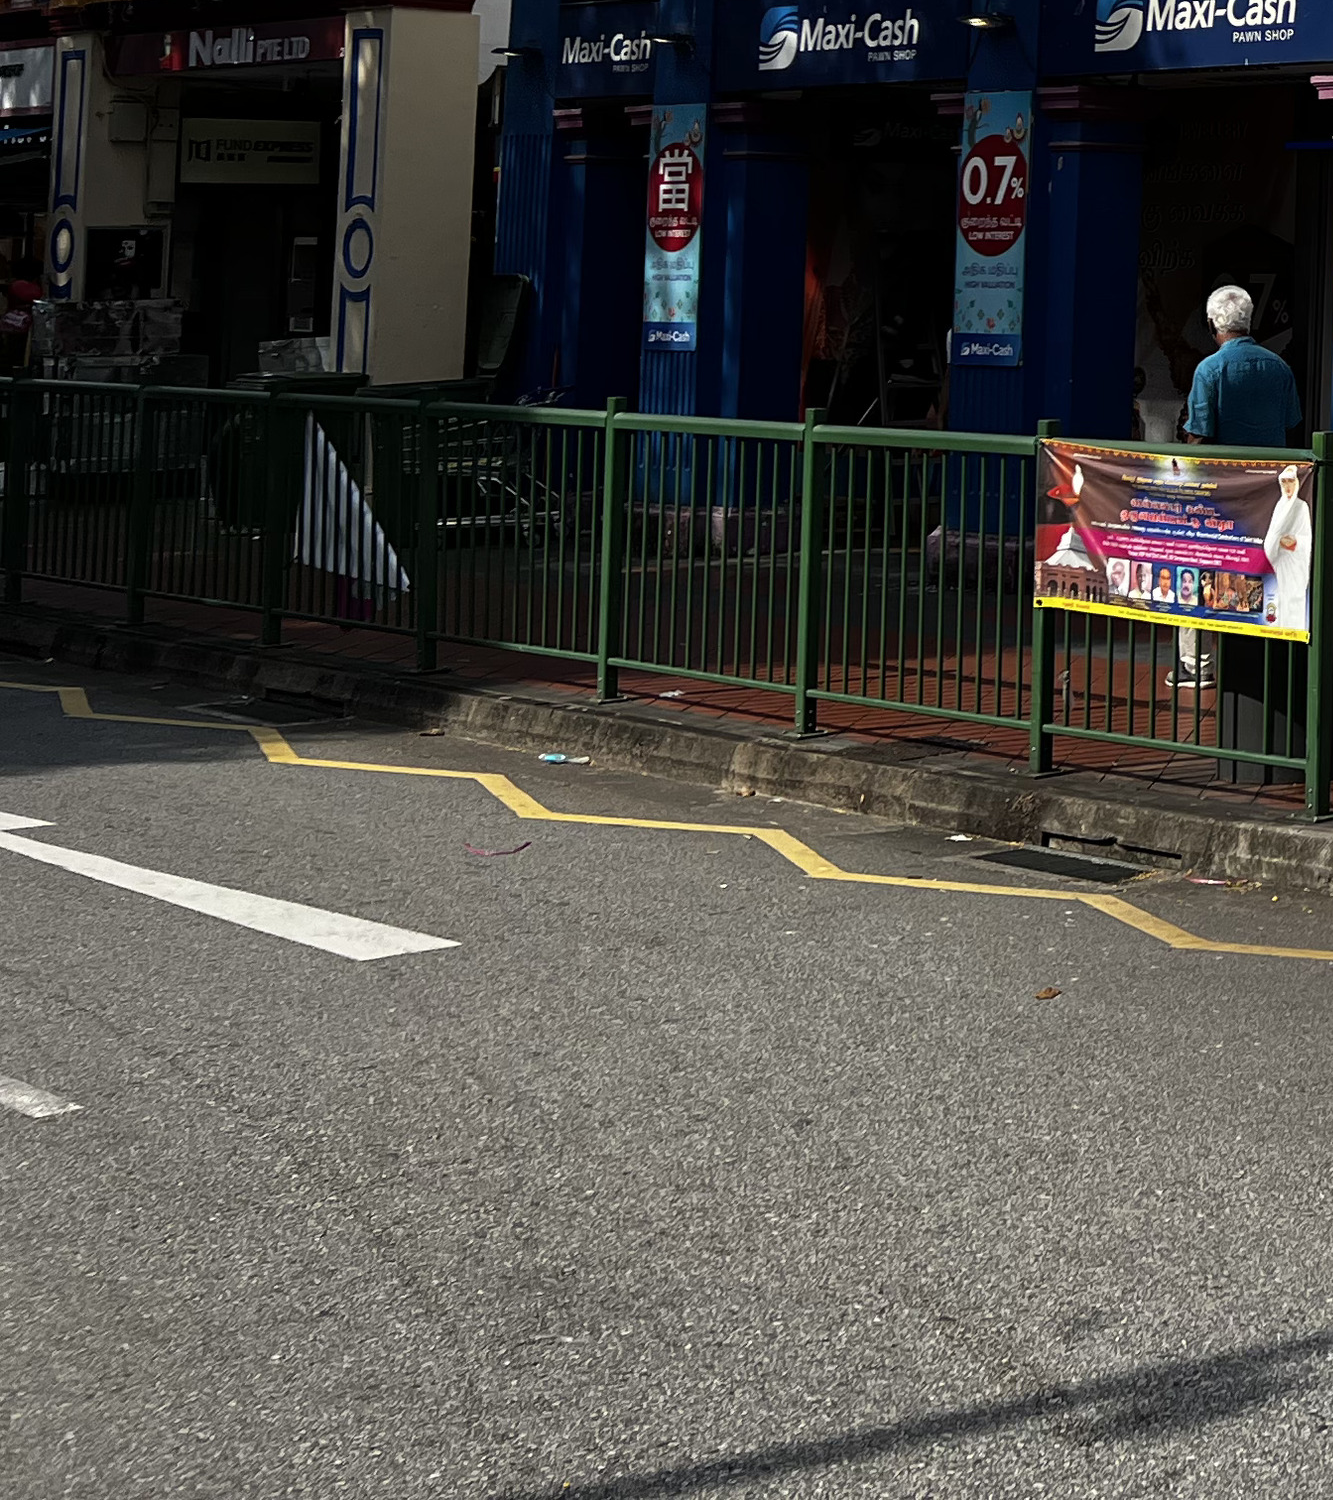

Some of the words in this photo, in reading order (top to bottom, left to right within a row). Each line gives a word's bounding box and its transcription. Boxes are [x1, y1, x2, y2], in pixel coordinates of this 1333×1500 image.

[189, 28, 255, 67] Nalli
[562, 30, 651, 65] Maxi-Cash
[799, 8, 920, 53] Maxi-Cash
[1233, 30, 1262, 43] PAWN
[1264, 28, 1294, 41] SHOP
[867, 51, 891, 62] PAWN
[892, 49, 917, 61] SHOP
[658, 148, 693, 212] 當
[962, 155, 1025, 206] 0.7%
[970, 340, 1013, 357] Maxi-Cash
